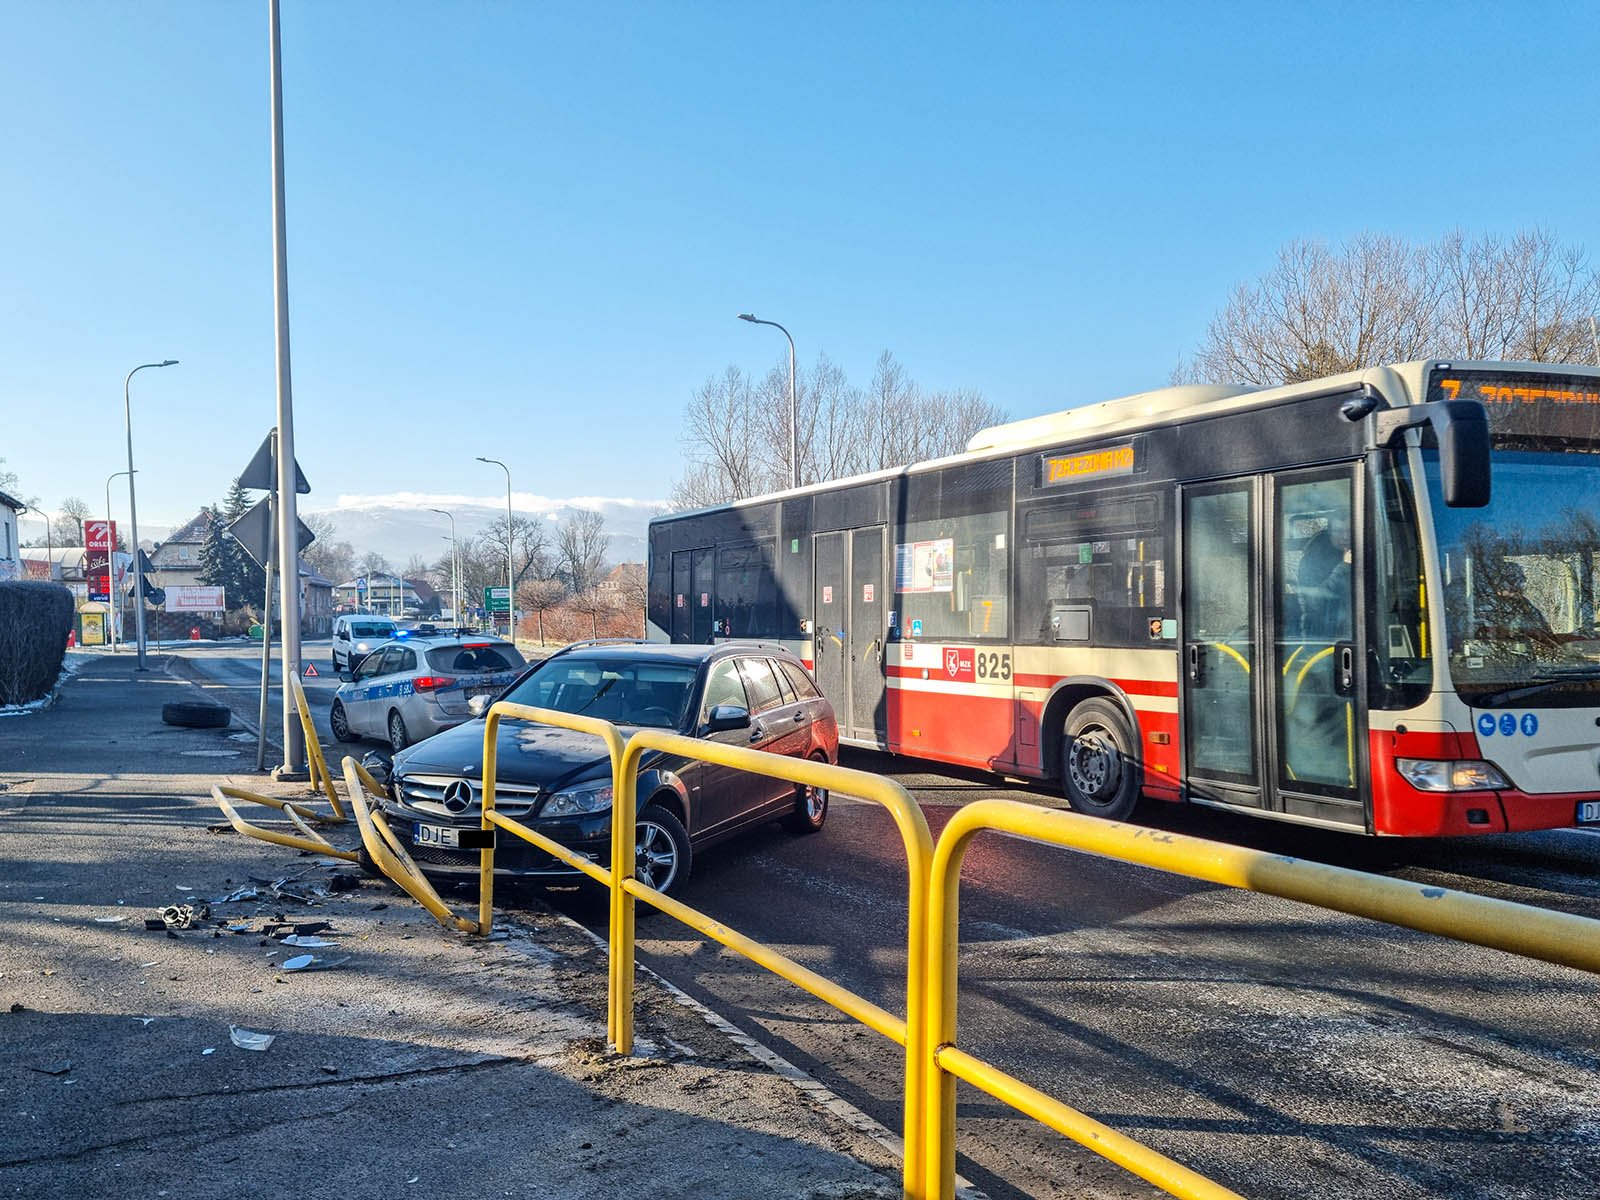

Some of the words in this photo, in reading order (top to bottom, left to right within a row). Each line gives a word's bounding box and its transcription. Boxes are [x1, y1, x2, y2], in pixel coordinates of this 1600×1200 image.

[1440, 379, 1461, 401] 7
[1048, 459, 1058, 482] 7
[960, 660, 972, 668] MZK
[977, 652, 1011, 680] 825
[421, 826, 451, 845] DJE
